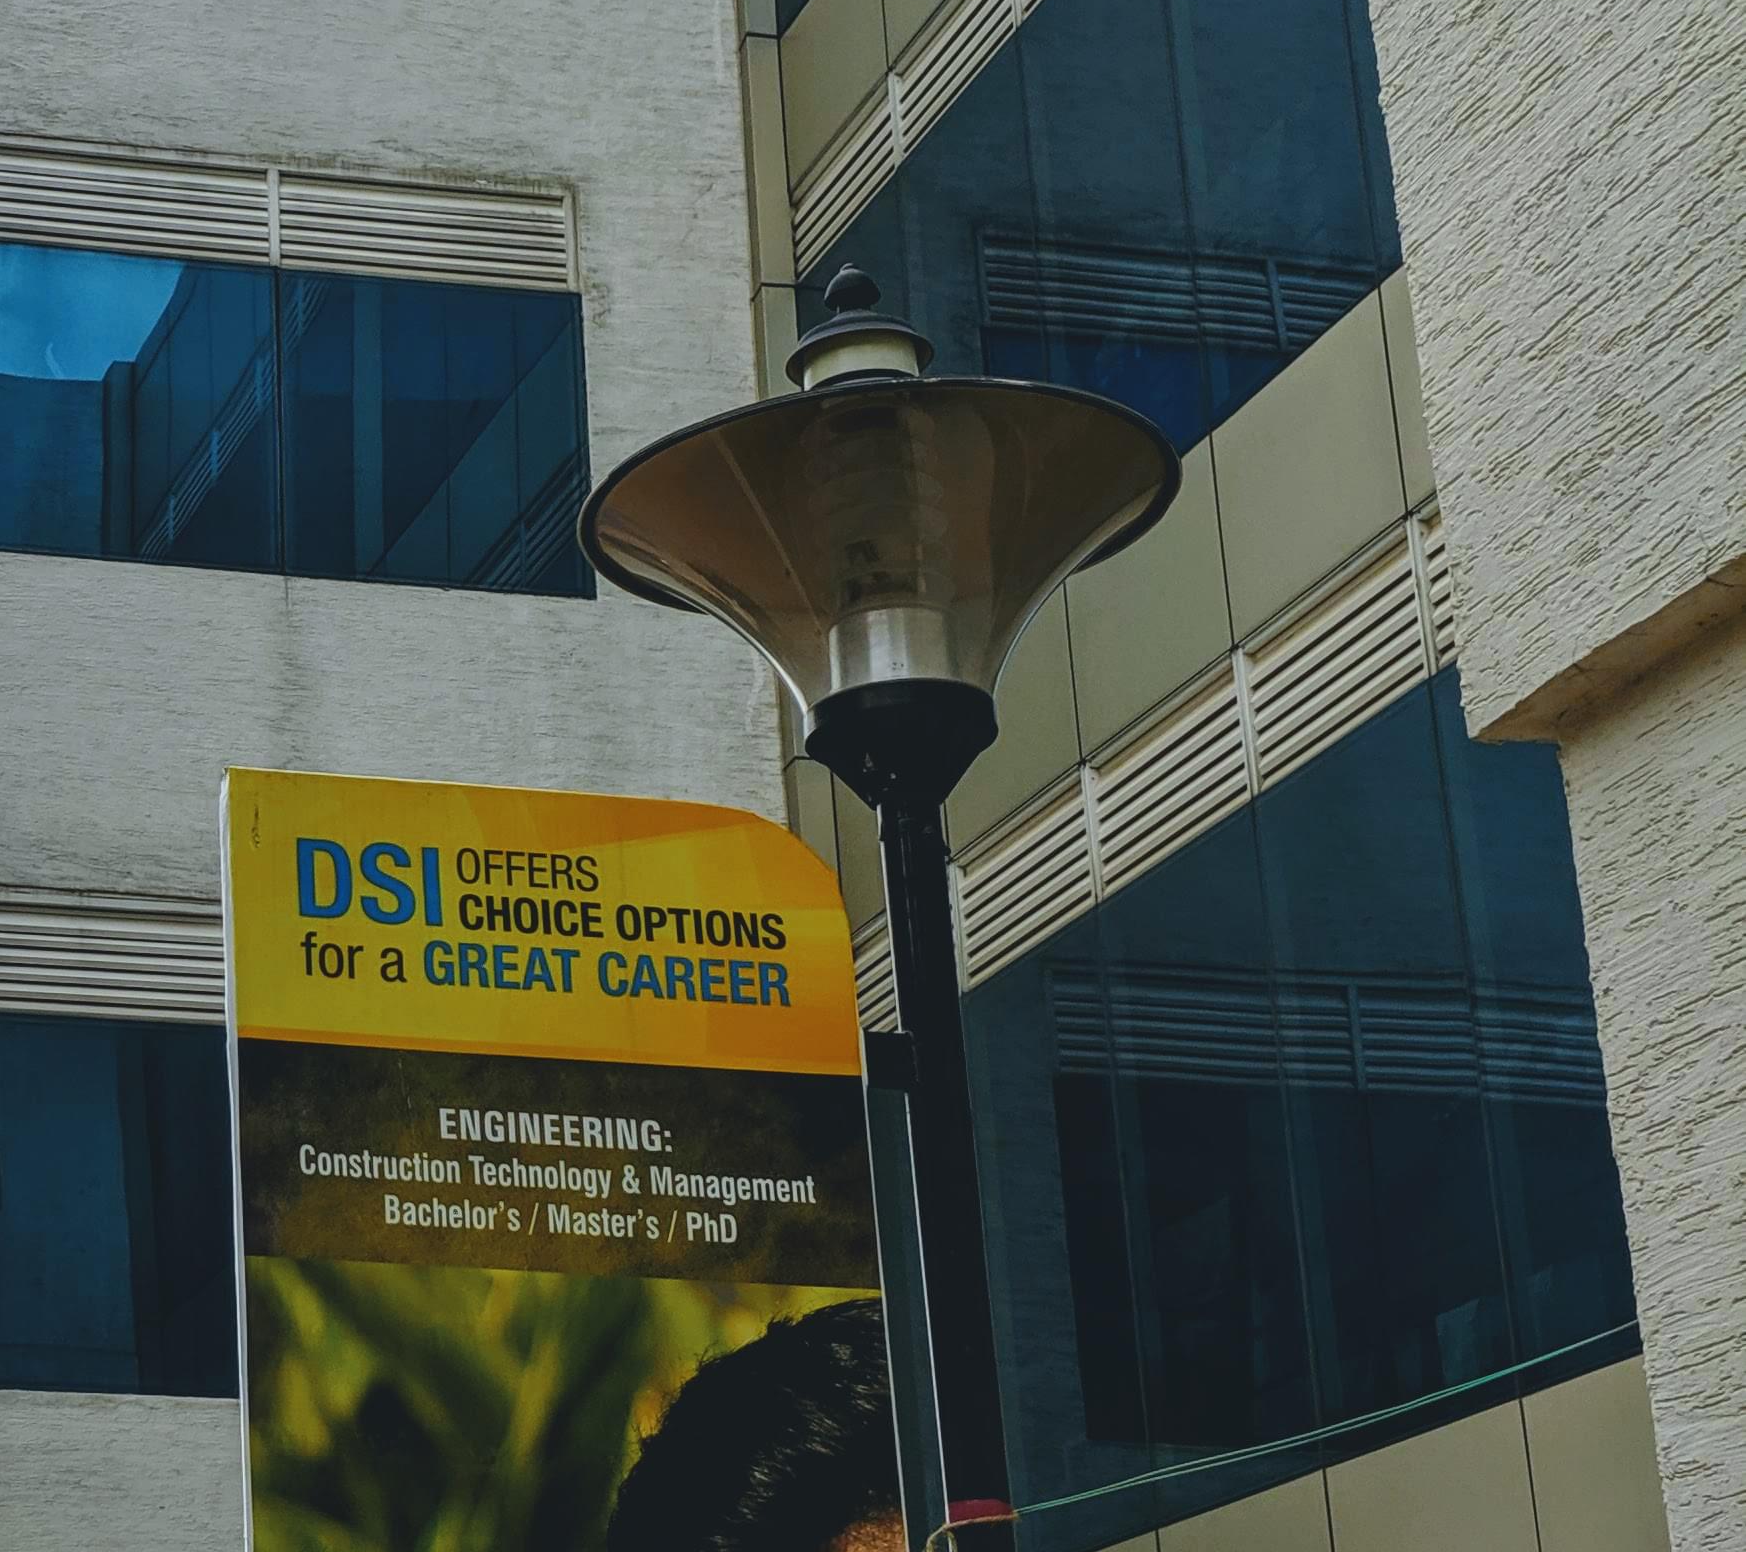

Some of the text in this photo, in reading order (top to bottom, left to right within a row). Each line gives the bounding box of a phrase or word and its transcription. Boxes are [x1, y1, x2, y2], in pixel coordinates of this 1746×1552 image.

[296, 837, 444, 927] DSI
[456, 847, 600, 892] OFFERS
[458, 893, 787, 950] CHOICE OPTIONS
[300, 931, 791, 1007] for a GREAT CAREER
[438, 1107, 674, 1153] ENGINEERING:
[298, 1144, 816, 1205] Construction Technology & Management
[685, 1211, 739, 1244] PhD
